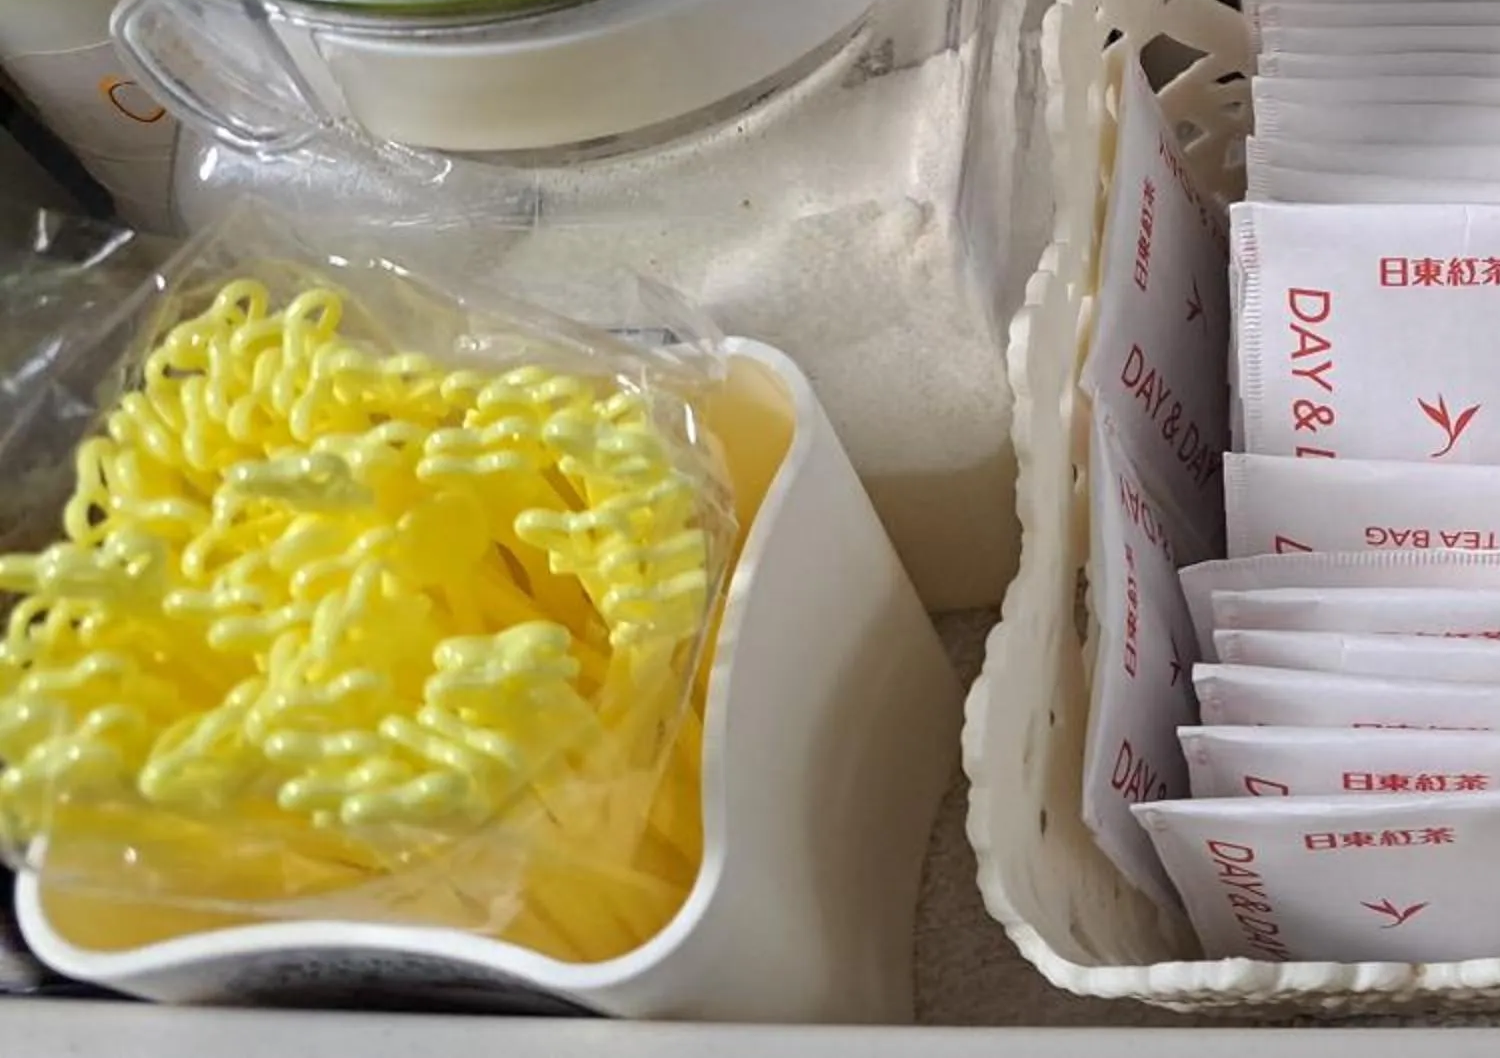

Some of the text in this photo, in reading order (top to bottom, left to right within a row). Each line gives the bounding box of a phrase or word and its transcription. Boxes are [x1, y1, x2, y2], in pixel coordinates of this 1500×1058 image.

[1288, 287, 1333, 392] DAY
[1121, 343, 1171, 412] DAY
[1292, 399, 1335, 433] &
[1365, 526, 1498, 550] TEA BAG
[1343, 772, 1491, 792] 日東紅茶
[1304, 827, 1455, 851] 日東紅茶
[1207, 840, 1266, 898] DAY
